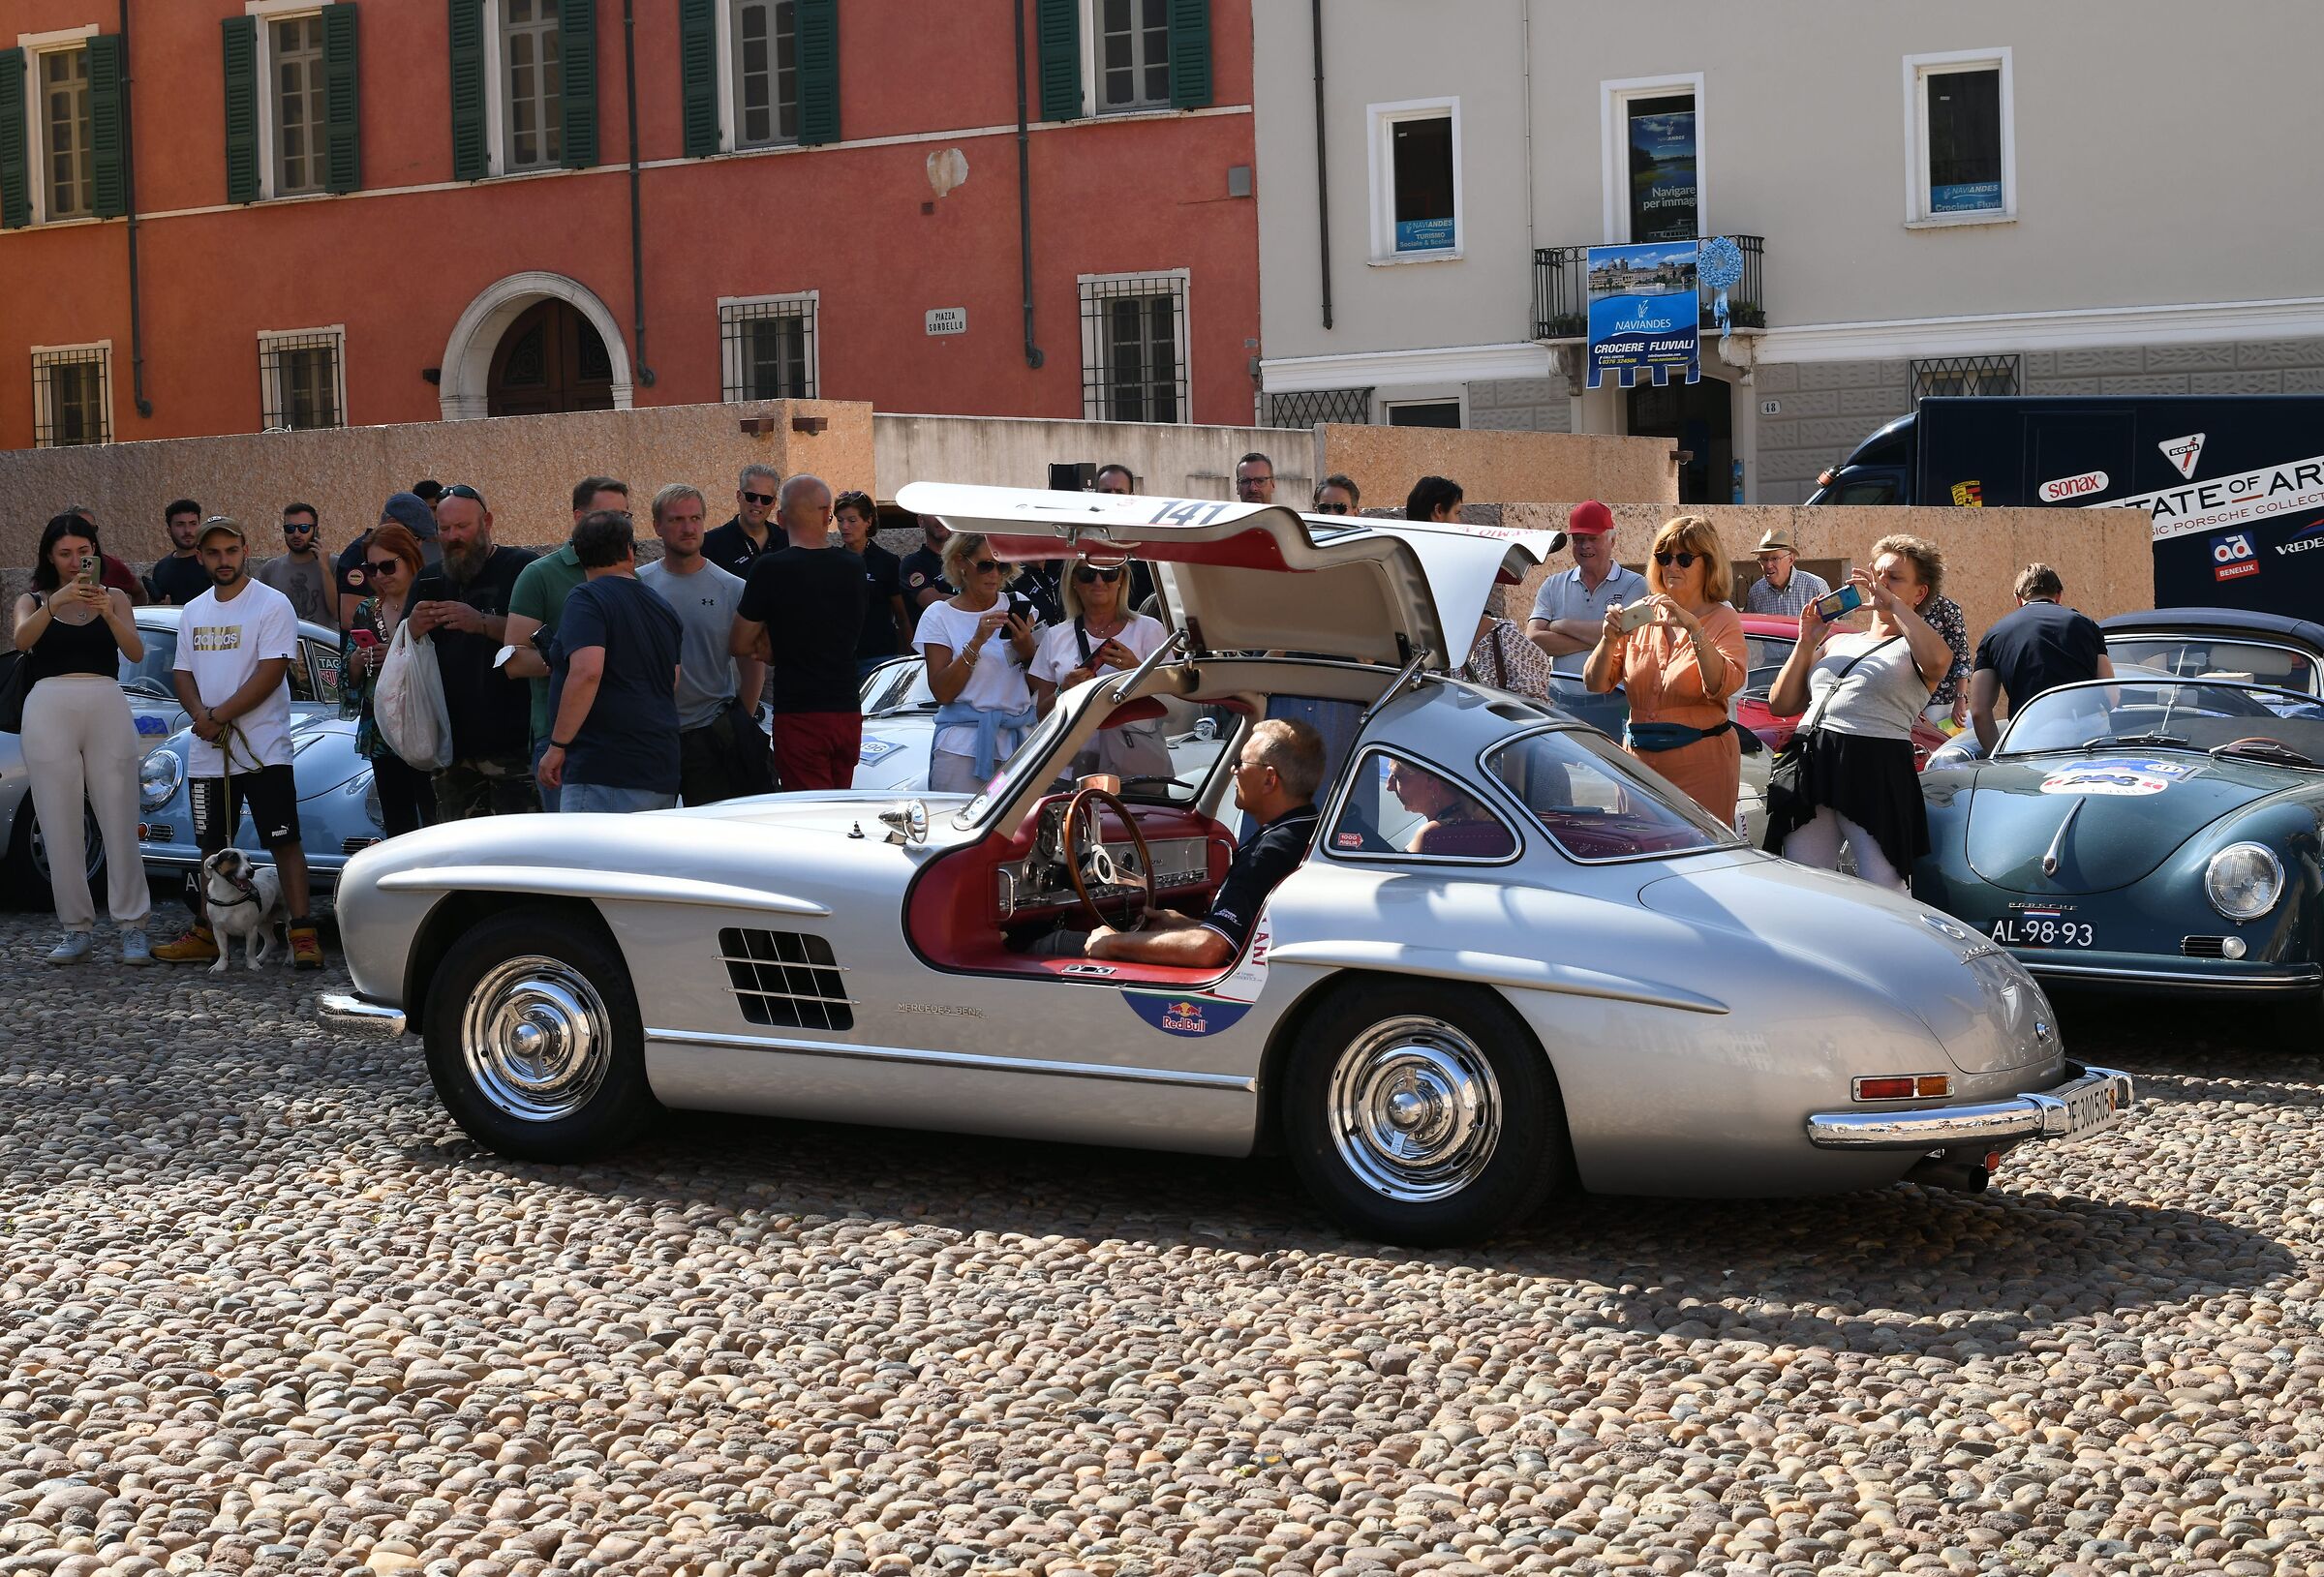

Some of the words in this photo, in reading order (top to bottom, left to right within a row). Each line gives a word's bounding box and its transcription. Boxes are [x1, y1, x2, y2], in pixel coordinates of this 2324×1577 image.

[1652, 186, 1696, 197] Navigare
[1952, 184, 1999, 194] NAVIANDES
[1643, 200, 1661, 211] per
[1413, 220, 1453, 229] NAVIANDES
[935, 312, 955, 320] PIAZZA
[929, 321, 963, 331] SORDELLO
[1615, 319, 1671, 330] NAVIANDES
[1594, 343, 1645, 353] CROCIERE
[1649, 340, 1695, 350] FLUVIALI
[2171, 444, 2198, 456] KONI
[2048, 473, 2100, 499] sonax
[2228, 475, 2261, 494] OF
[2267, 461, 2324, 497] AR
[1147, 500, 1232, 526] 141
[2174, 508, 2250, 531] PORSCHE
[2275, 536, 2324, 556] VREDE
[2219, 563, 2255, 577] BENELUX
[194, 632, 237, 646] adidas
[319, 658, 339, 669] TAG
[321, 670, 338, 686] HEU
[194, 783, 207, 830] PUMA
[1990, 920, 2093, 947] AL-98-93
[898, 1002, 951, 1014] MERCEDES
[956, 1007, 983, 1016] BENZ
[1163, 1016, 1183, 1029] Red
[1184, 1018, 1206, 1032] Bull
